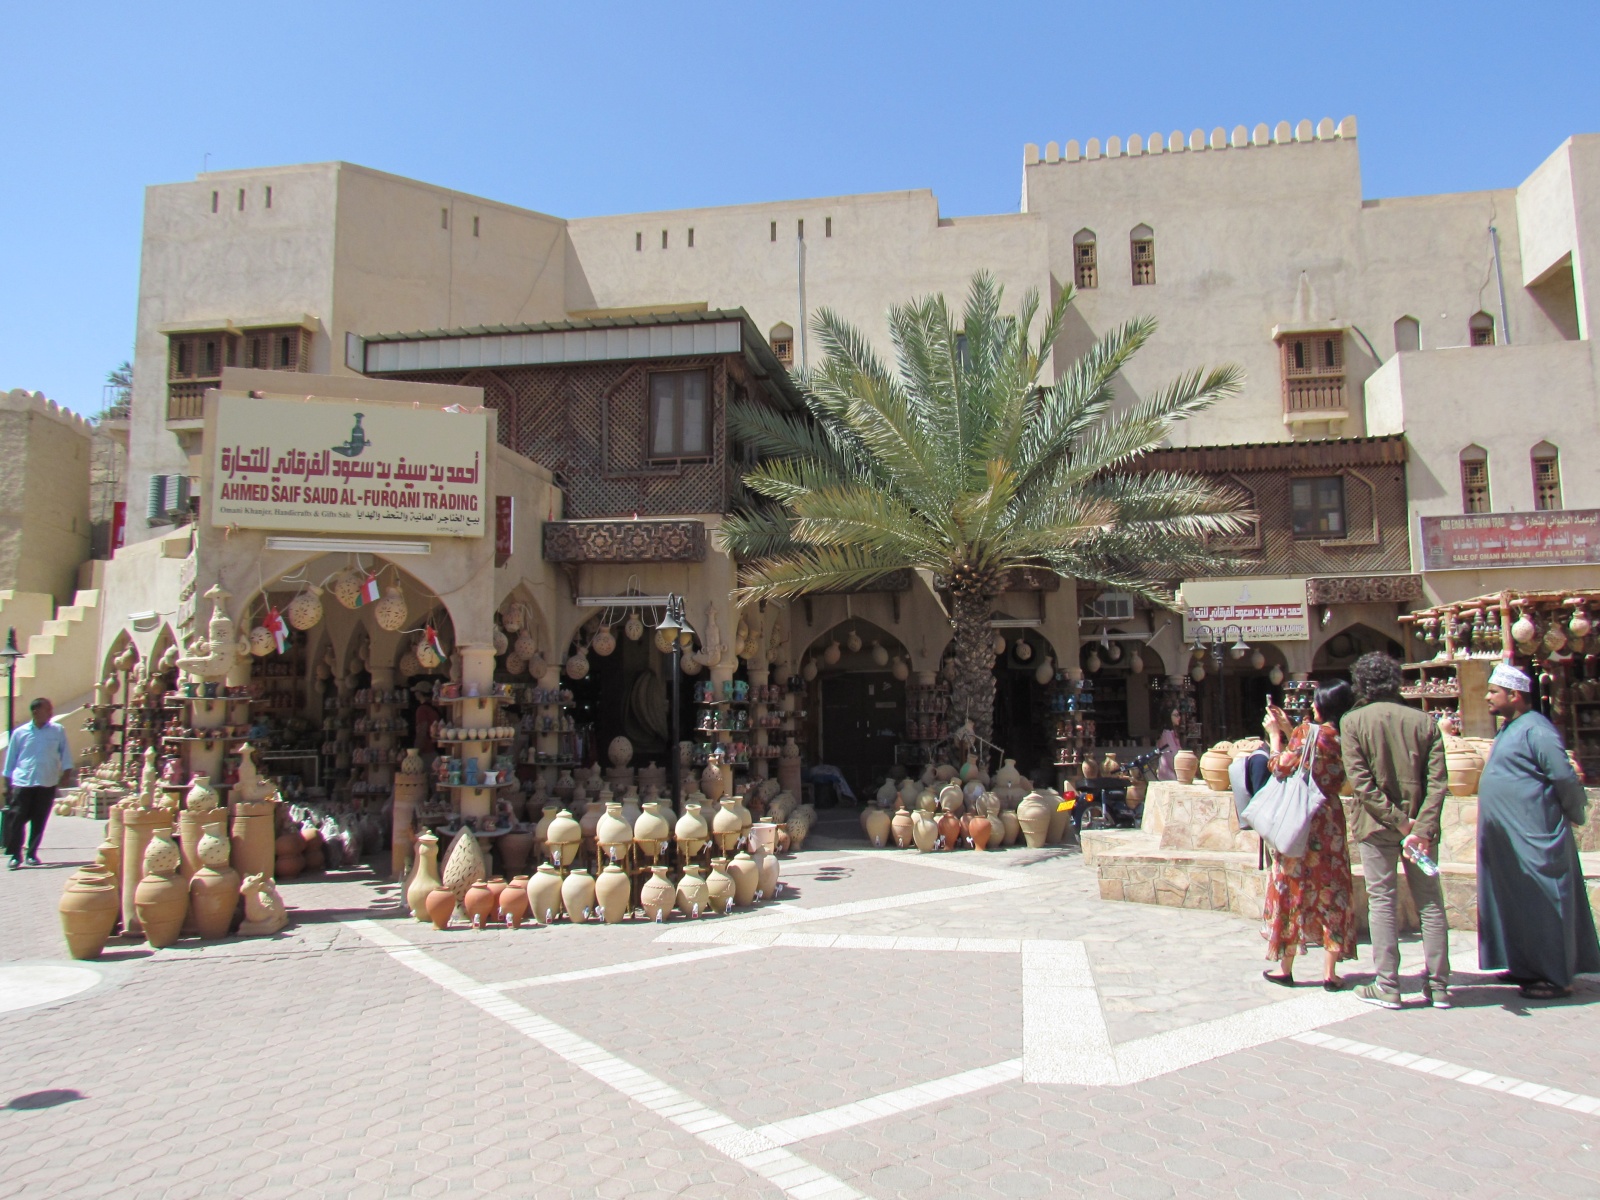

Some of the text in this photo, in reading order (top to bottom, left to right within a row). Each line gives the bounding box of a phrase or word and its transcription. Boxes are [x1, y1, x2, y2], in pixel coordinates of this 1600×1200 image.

[221, 445, 478, 490] أحمد بن سيف بن سعود الفرقاني للتجارة
[220, 482, 478, 511] AHMED SAIF SAUD AL-FURQANI TRADING
[220, 506, 242, 514] Omani
[274, 508, 311, 517] Handicrafts
[313, 510, 319, 518] &
[321, 510, 336, 518] Gifts
[356, 509, 480, 526] بيع الخناجر العمانية والتحف والهدايا
[1480, 552, 1500, 560] OMANI
[1535, 550, 1553, 558] GIFTS
